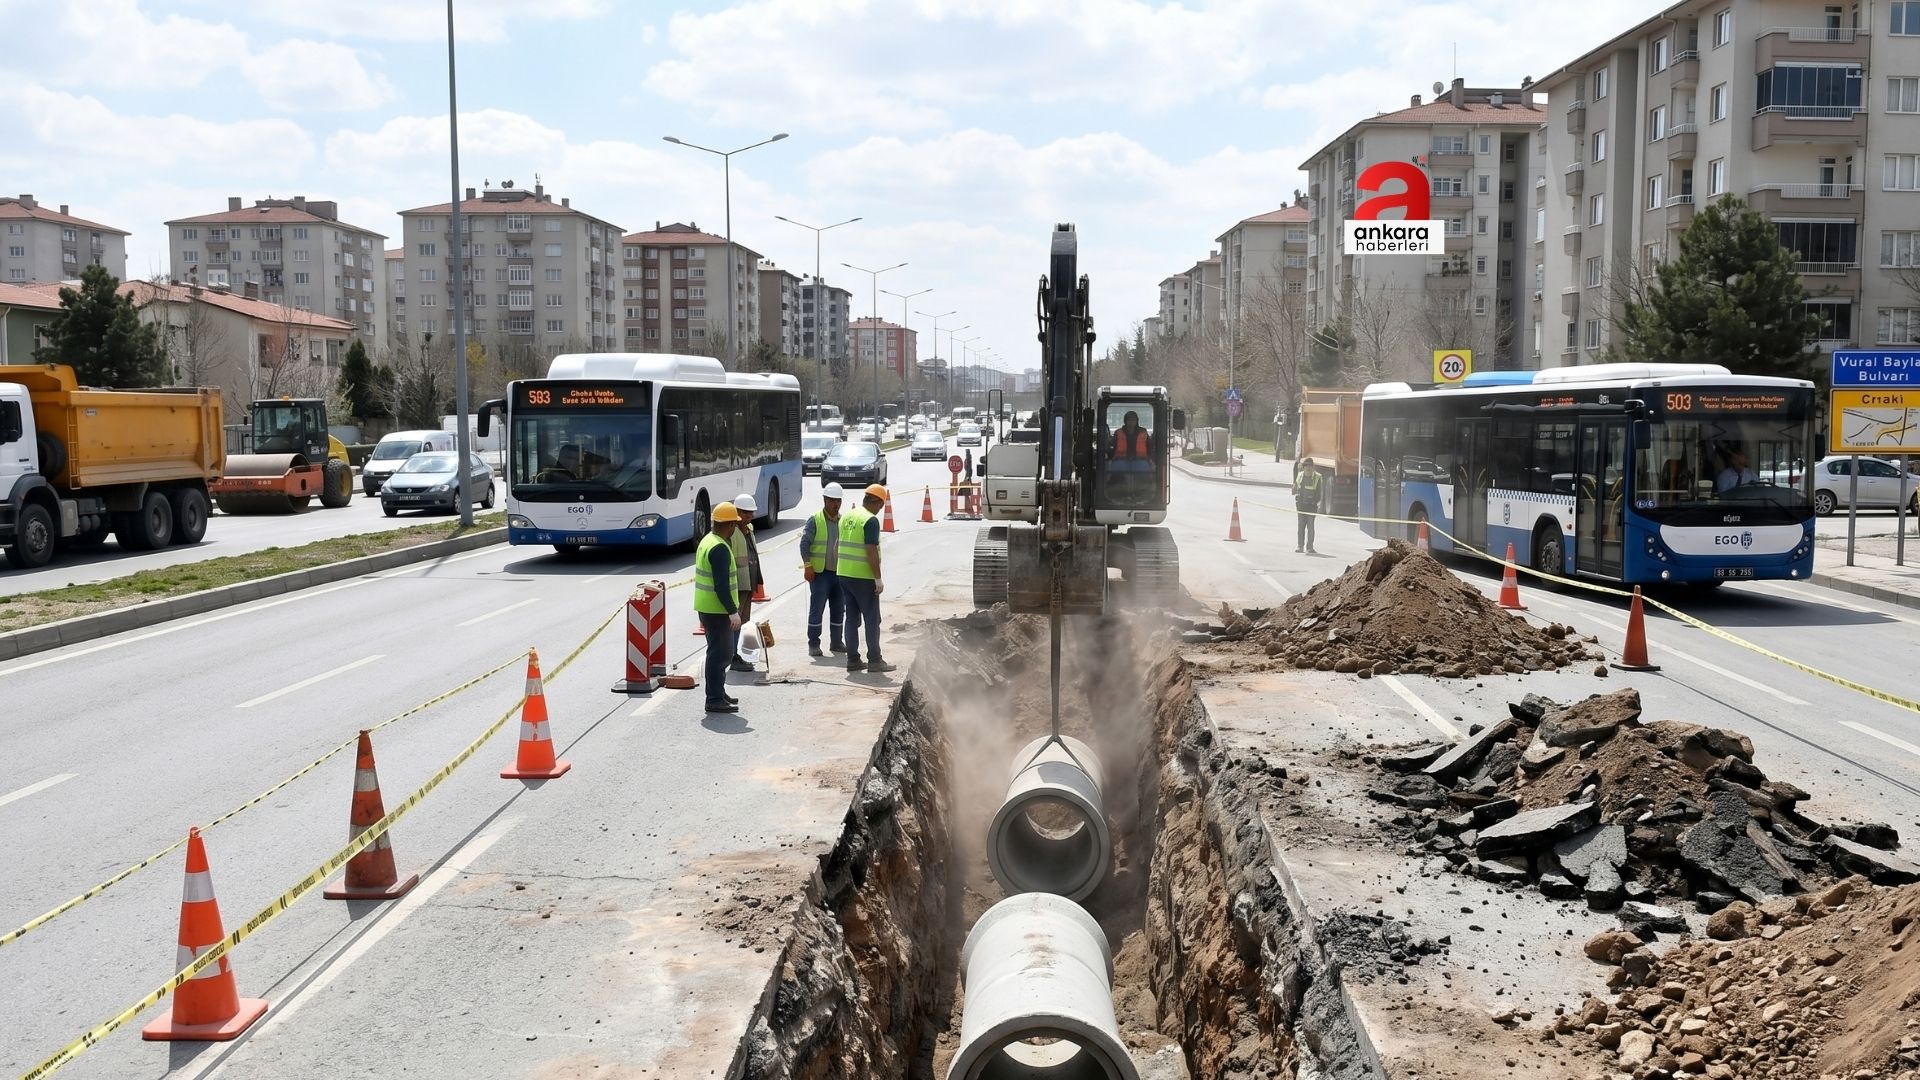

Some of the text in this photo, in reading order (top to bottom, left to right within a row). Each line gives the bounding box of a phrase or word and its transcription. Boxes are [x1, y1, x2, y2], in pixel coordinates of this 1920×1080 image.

[1840, 357, 1877, 367] Vural
[1859, 371, 1909, 381] Bulvarı
[1667, 393, 1692, 410] 503
[567, 506, 585, 514] EGO
[1714, 535, 1739, 545] EGO
